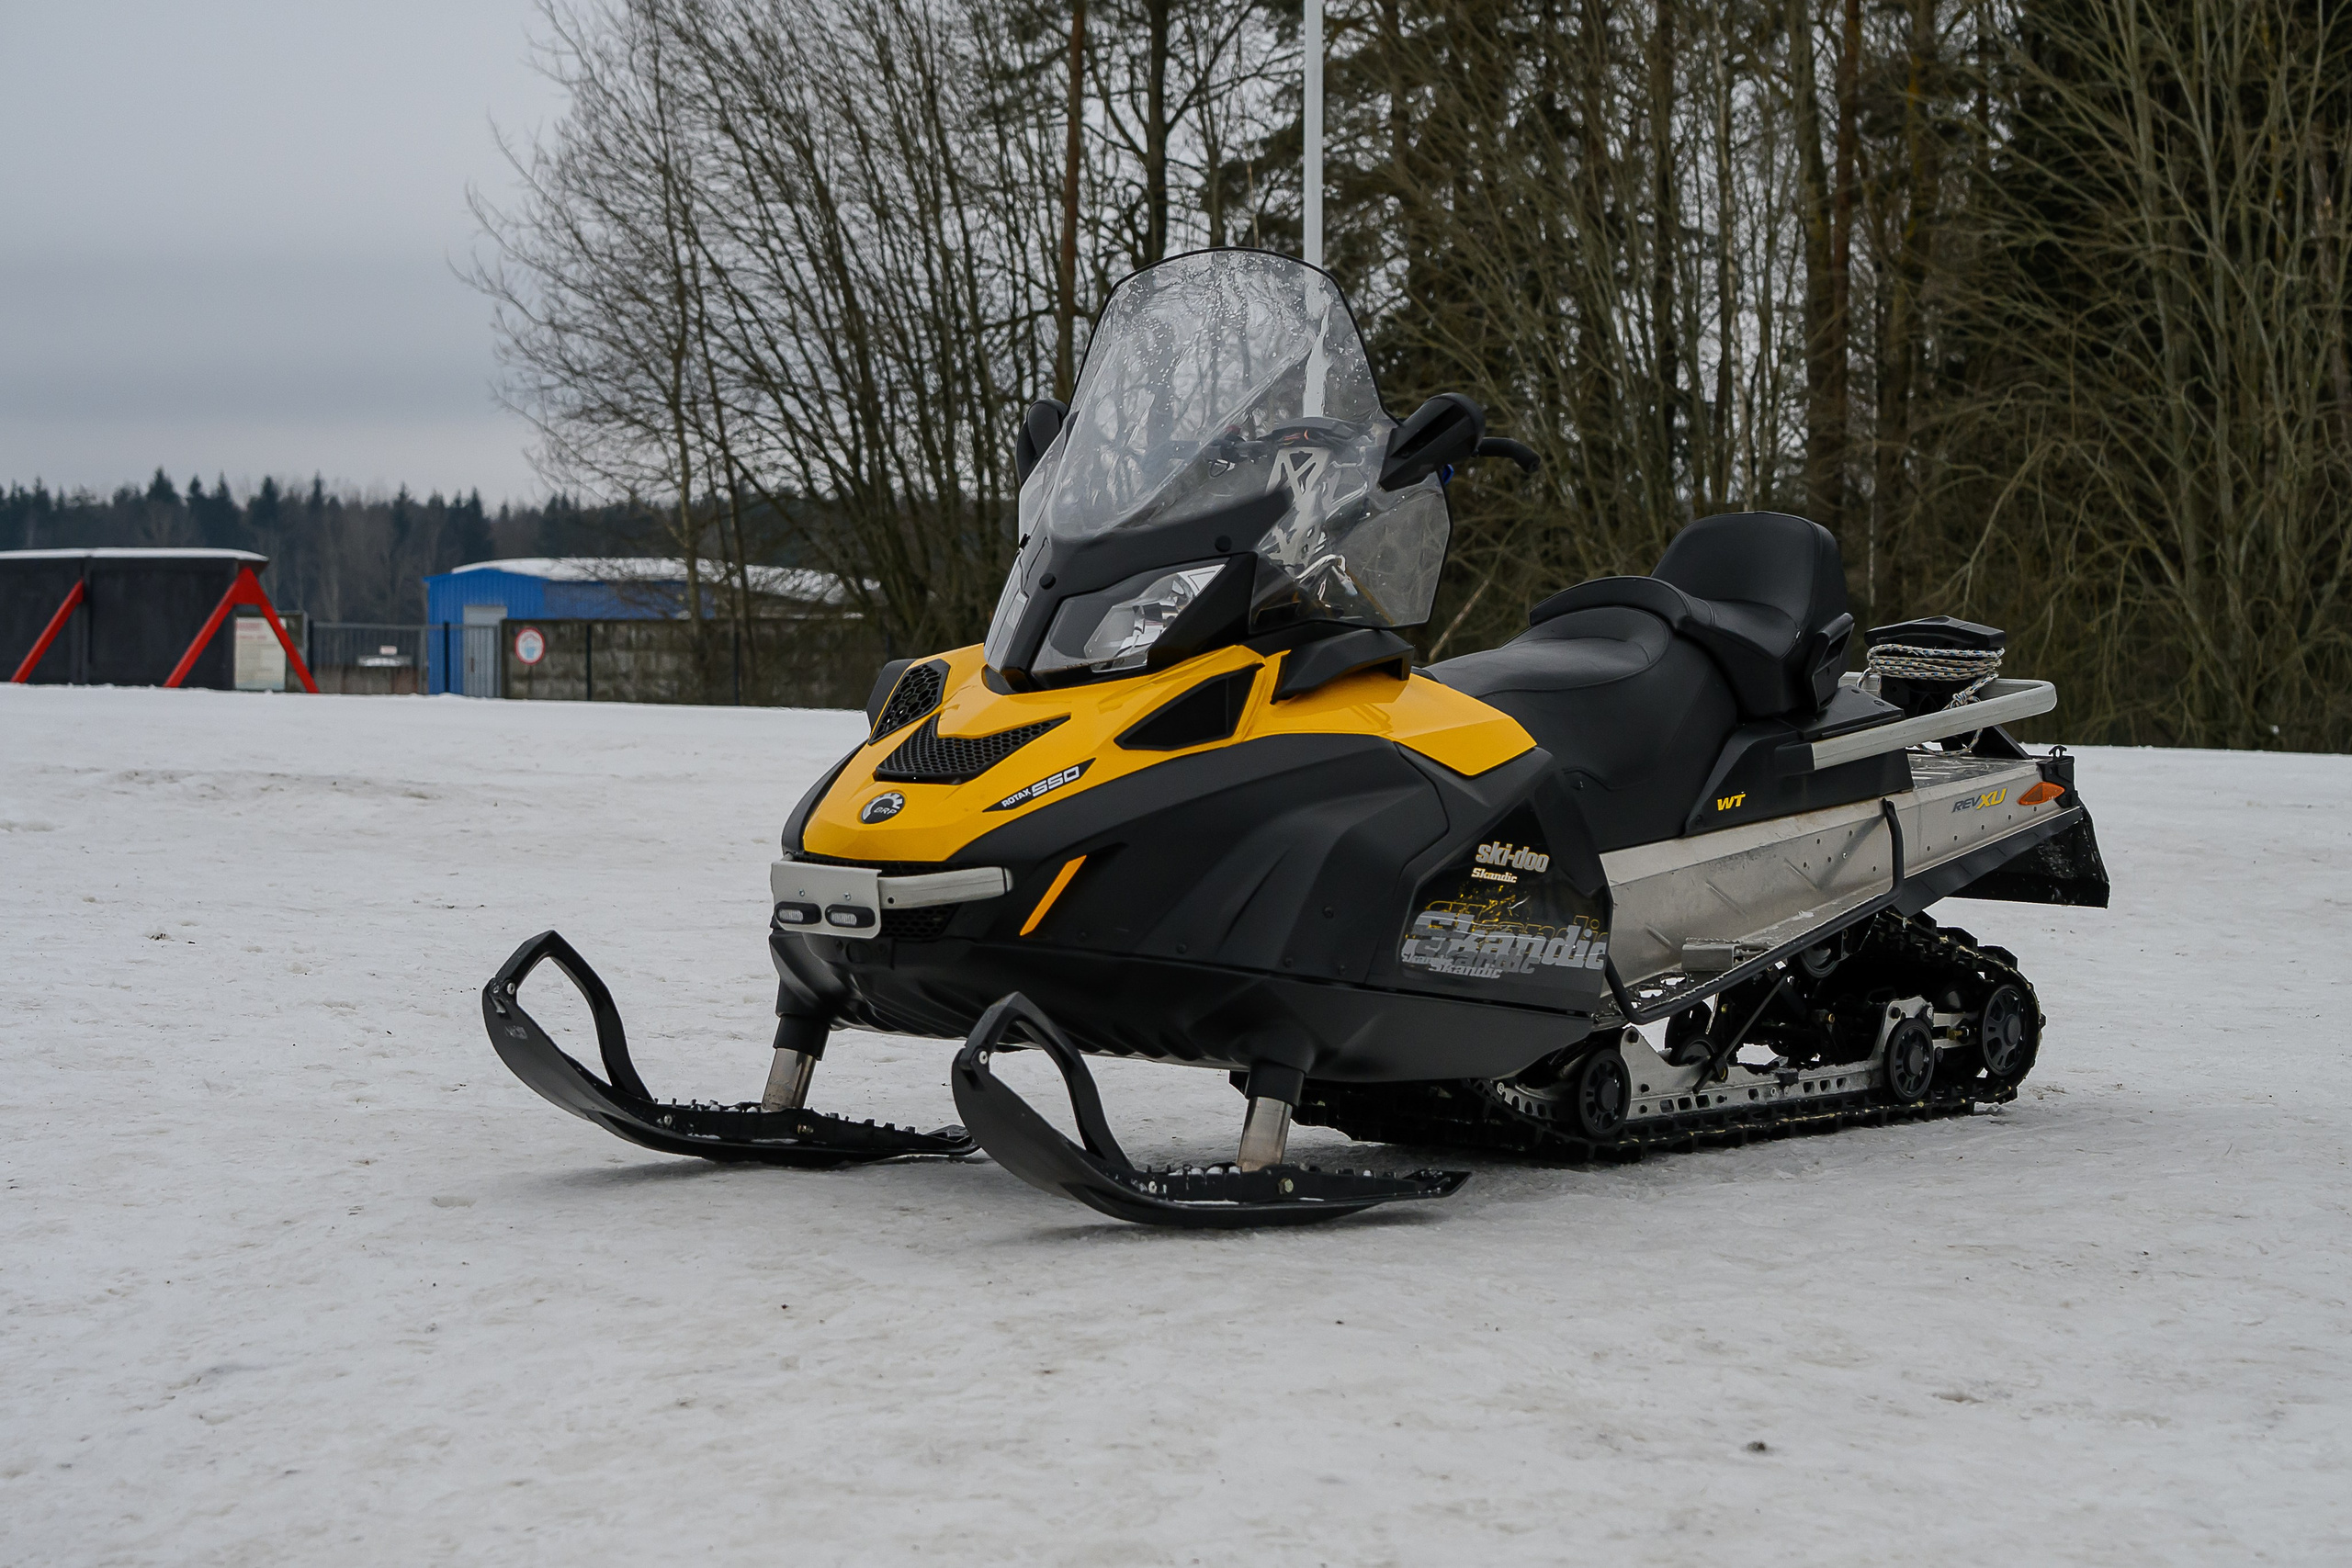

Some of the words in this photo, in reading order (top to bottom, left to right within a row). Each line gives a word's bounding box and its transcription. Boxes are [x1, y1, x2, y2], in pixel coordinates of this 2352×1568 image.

[1001, 788, 1031, 807] ROTAX
[1031, 765, 1080, 797] 550
[1717, 793, 1747, 811] WT
[874, 807, 898, 815] BRP
[1476, 840, 1550, 873] ski-doo
[1471, 867, 1518, 883] Skandic
[1428, 962, 1504, 979] Skandic
